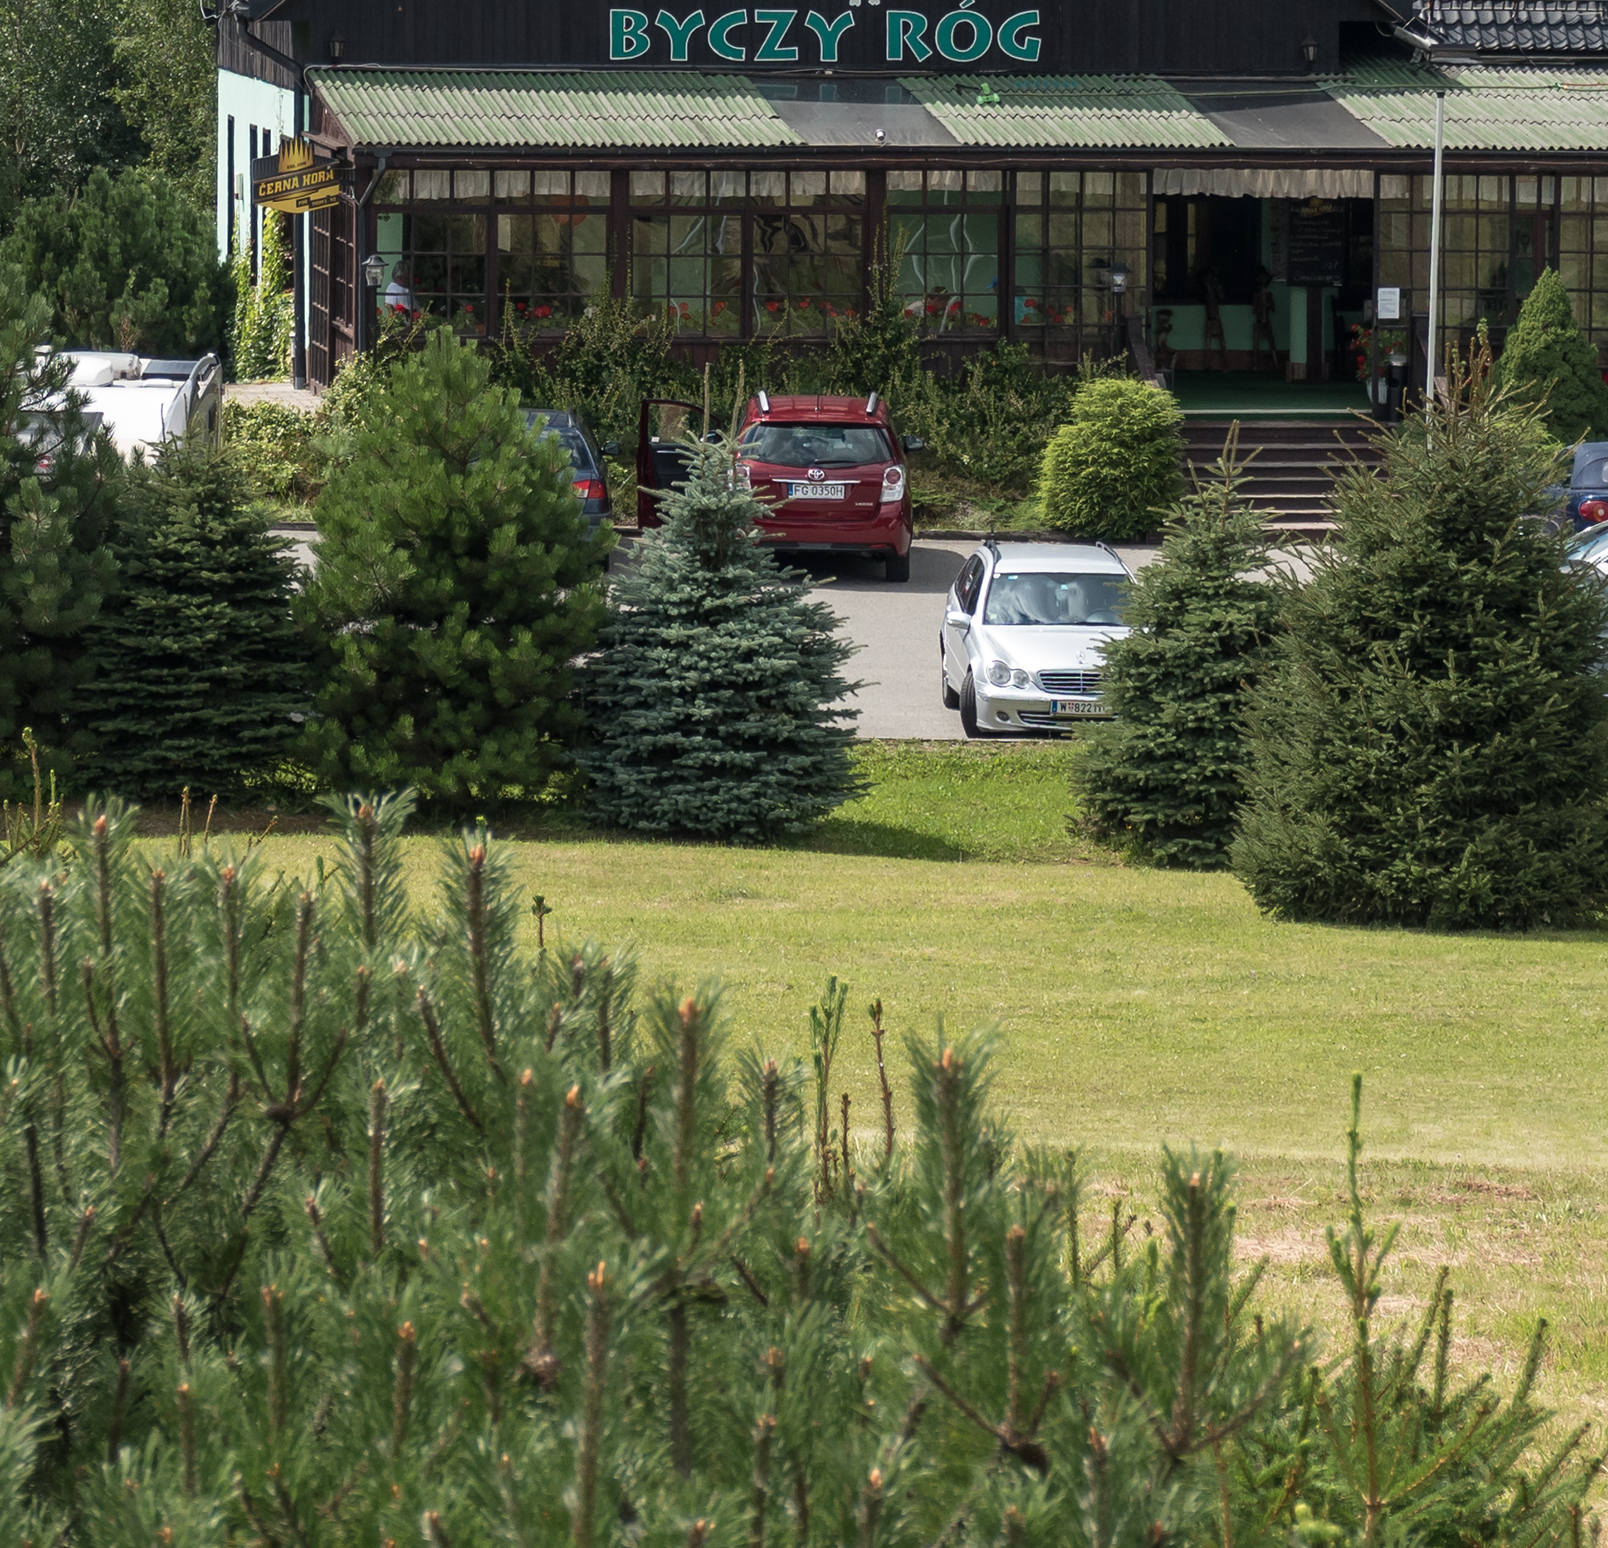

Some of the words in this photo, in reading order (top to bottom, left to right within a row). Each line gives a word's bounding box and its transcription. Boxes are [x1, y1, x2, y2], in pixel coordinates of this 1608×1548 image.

[609, 9, 855, 62] BYCZY
[302, 169, 335, 187] HORA
[794, 485, 809, 495] FG
